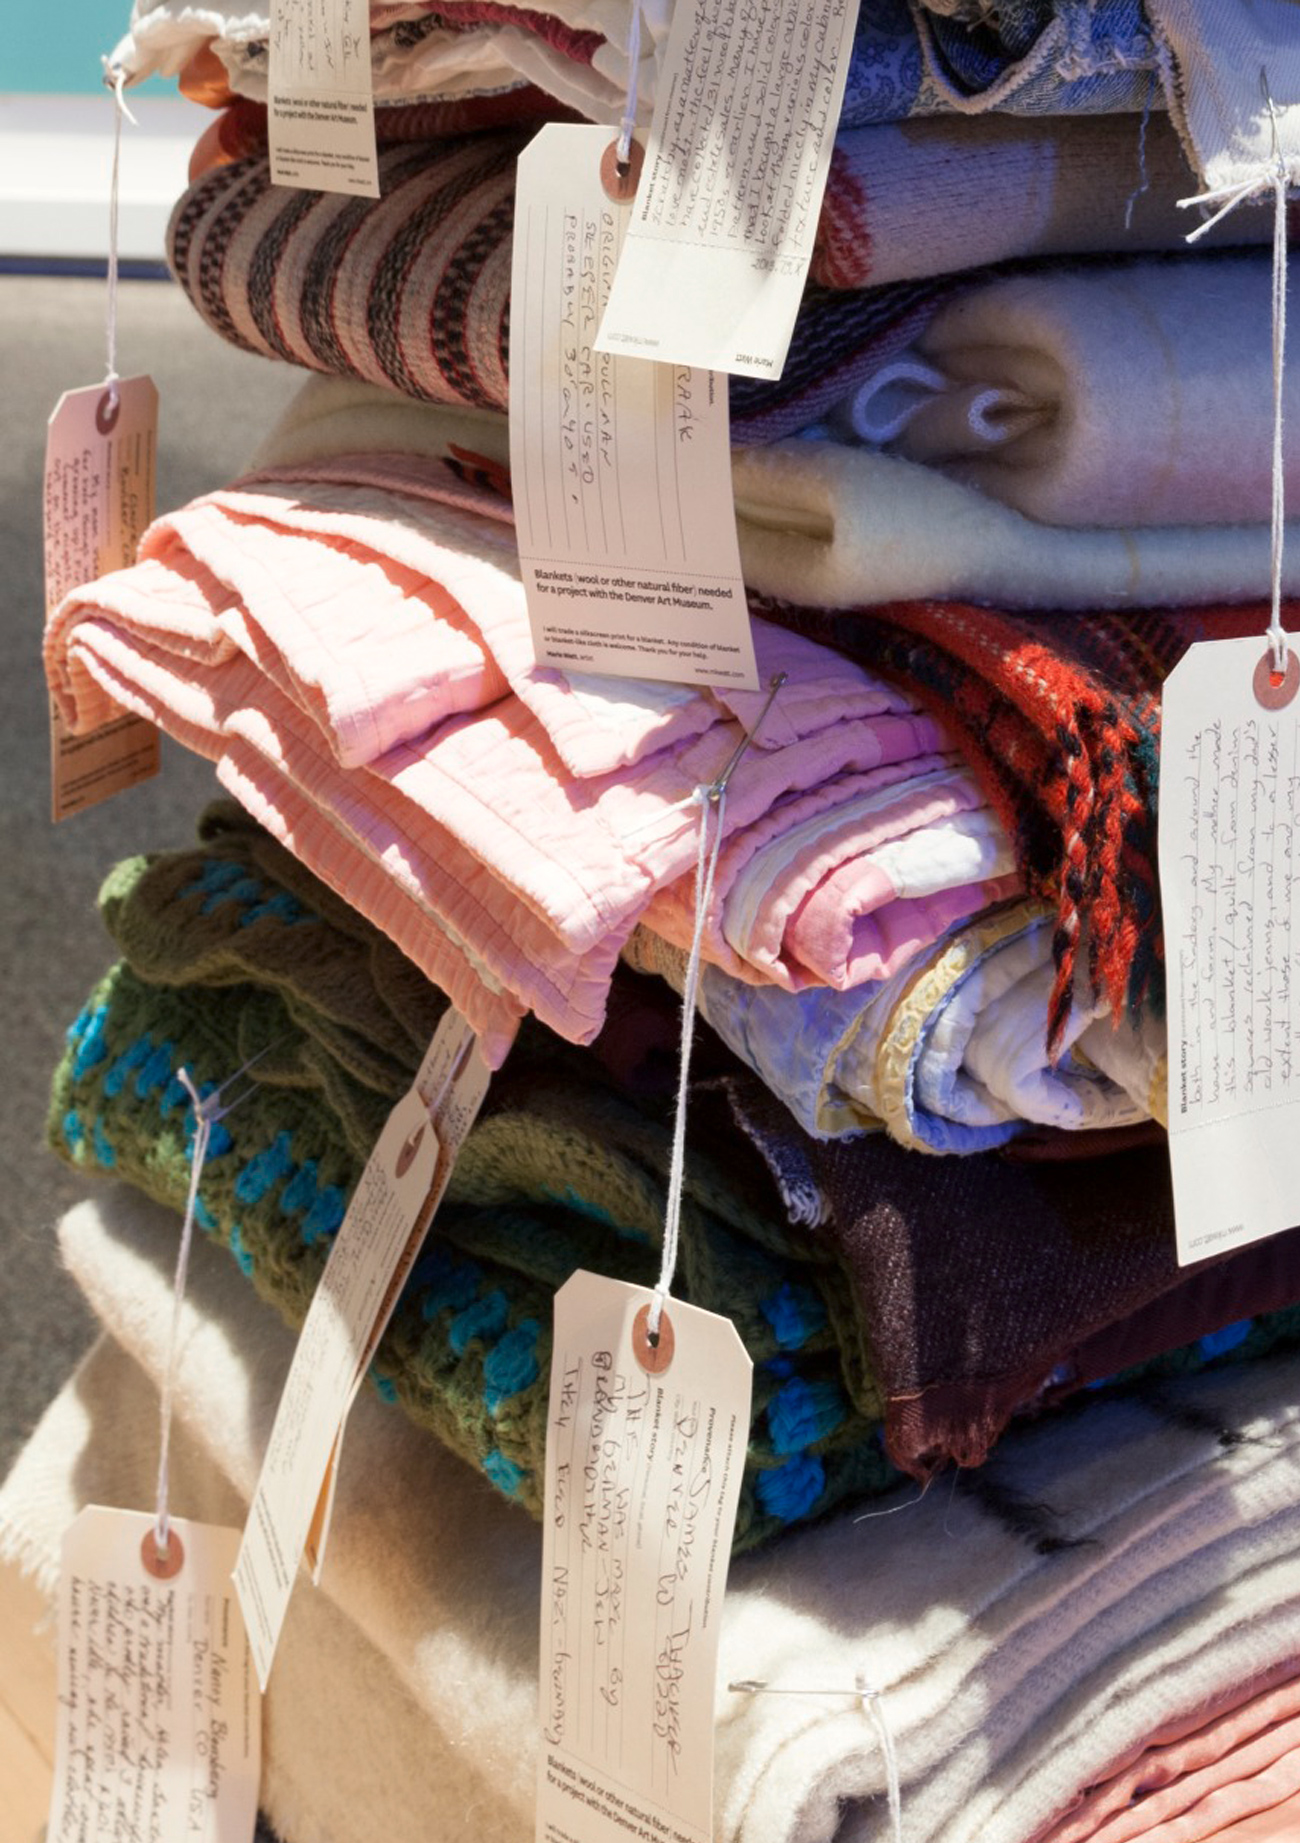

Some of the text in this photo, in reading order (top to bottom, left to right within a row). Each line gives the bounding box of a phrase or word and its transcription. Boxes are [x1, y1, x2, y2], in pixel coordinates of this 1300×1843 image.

[693, 46, 714, 83] feel
[749, 60, 774, 105] solid
[767, 49, 797, 97] large
[686, 86, 704, 115] the
[705, 81, 721, 100] 31
[640, 154, 663, 220] Blanket story
[768, 96, 819, 249] folded nicely in
[754, 358, 773, 368] Marie
[534, 569, 573, 582] Blankets
[600, 577, 610, 585] or
[611, 576, 636, 588] other
[638, 579, 671, 593] natural
[698, 587, 733, 600] needed
[537, 582, 550, 593] for
[557, 586, 588, 599] project
[588, 588, 608, 600] with
[609, 590, 624, 601] the
[625, 592, 656, 604] Denver
[657, 596, 672, 606] Art
[673, 598, 714, 611] Museum.
[1219, 727, 1239, 789] denim
[1219, 800, 1237, 850] from
[1179, 730, 1202, 1105] both the and around the
[1199, 717, 1223, 1104] house and farm. My mother made
[1219, 873, 1238, 925] quilt
[1236, 718, 1265, 1093] squares reclaimed from my dad's
[1254, 722, 1278, 1091] old work and lesser
[1274, 775, 1300, 1084] extent those and my
[1179, 1039, 1188, 1113] Blanket story
[1223, 1056, 1236, 1096] this
[646, 1386, 664, 1462] Blanket story
[700, 1405, 716, 1474] Provenance
[720, 1472, 729, 1490] this
[723, 1442, 733, 1472] attach
[717, 1490, 726, 1505] tag
[712, 1516, 720, 1537] your
[707, 1538, 718, 1572] blanket
[192, 1638, 210, 1712] Denver
[195, 1729, 210, 1756] CO
